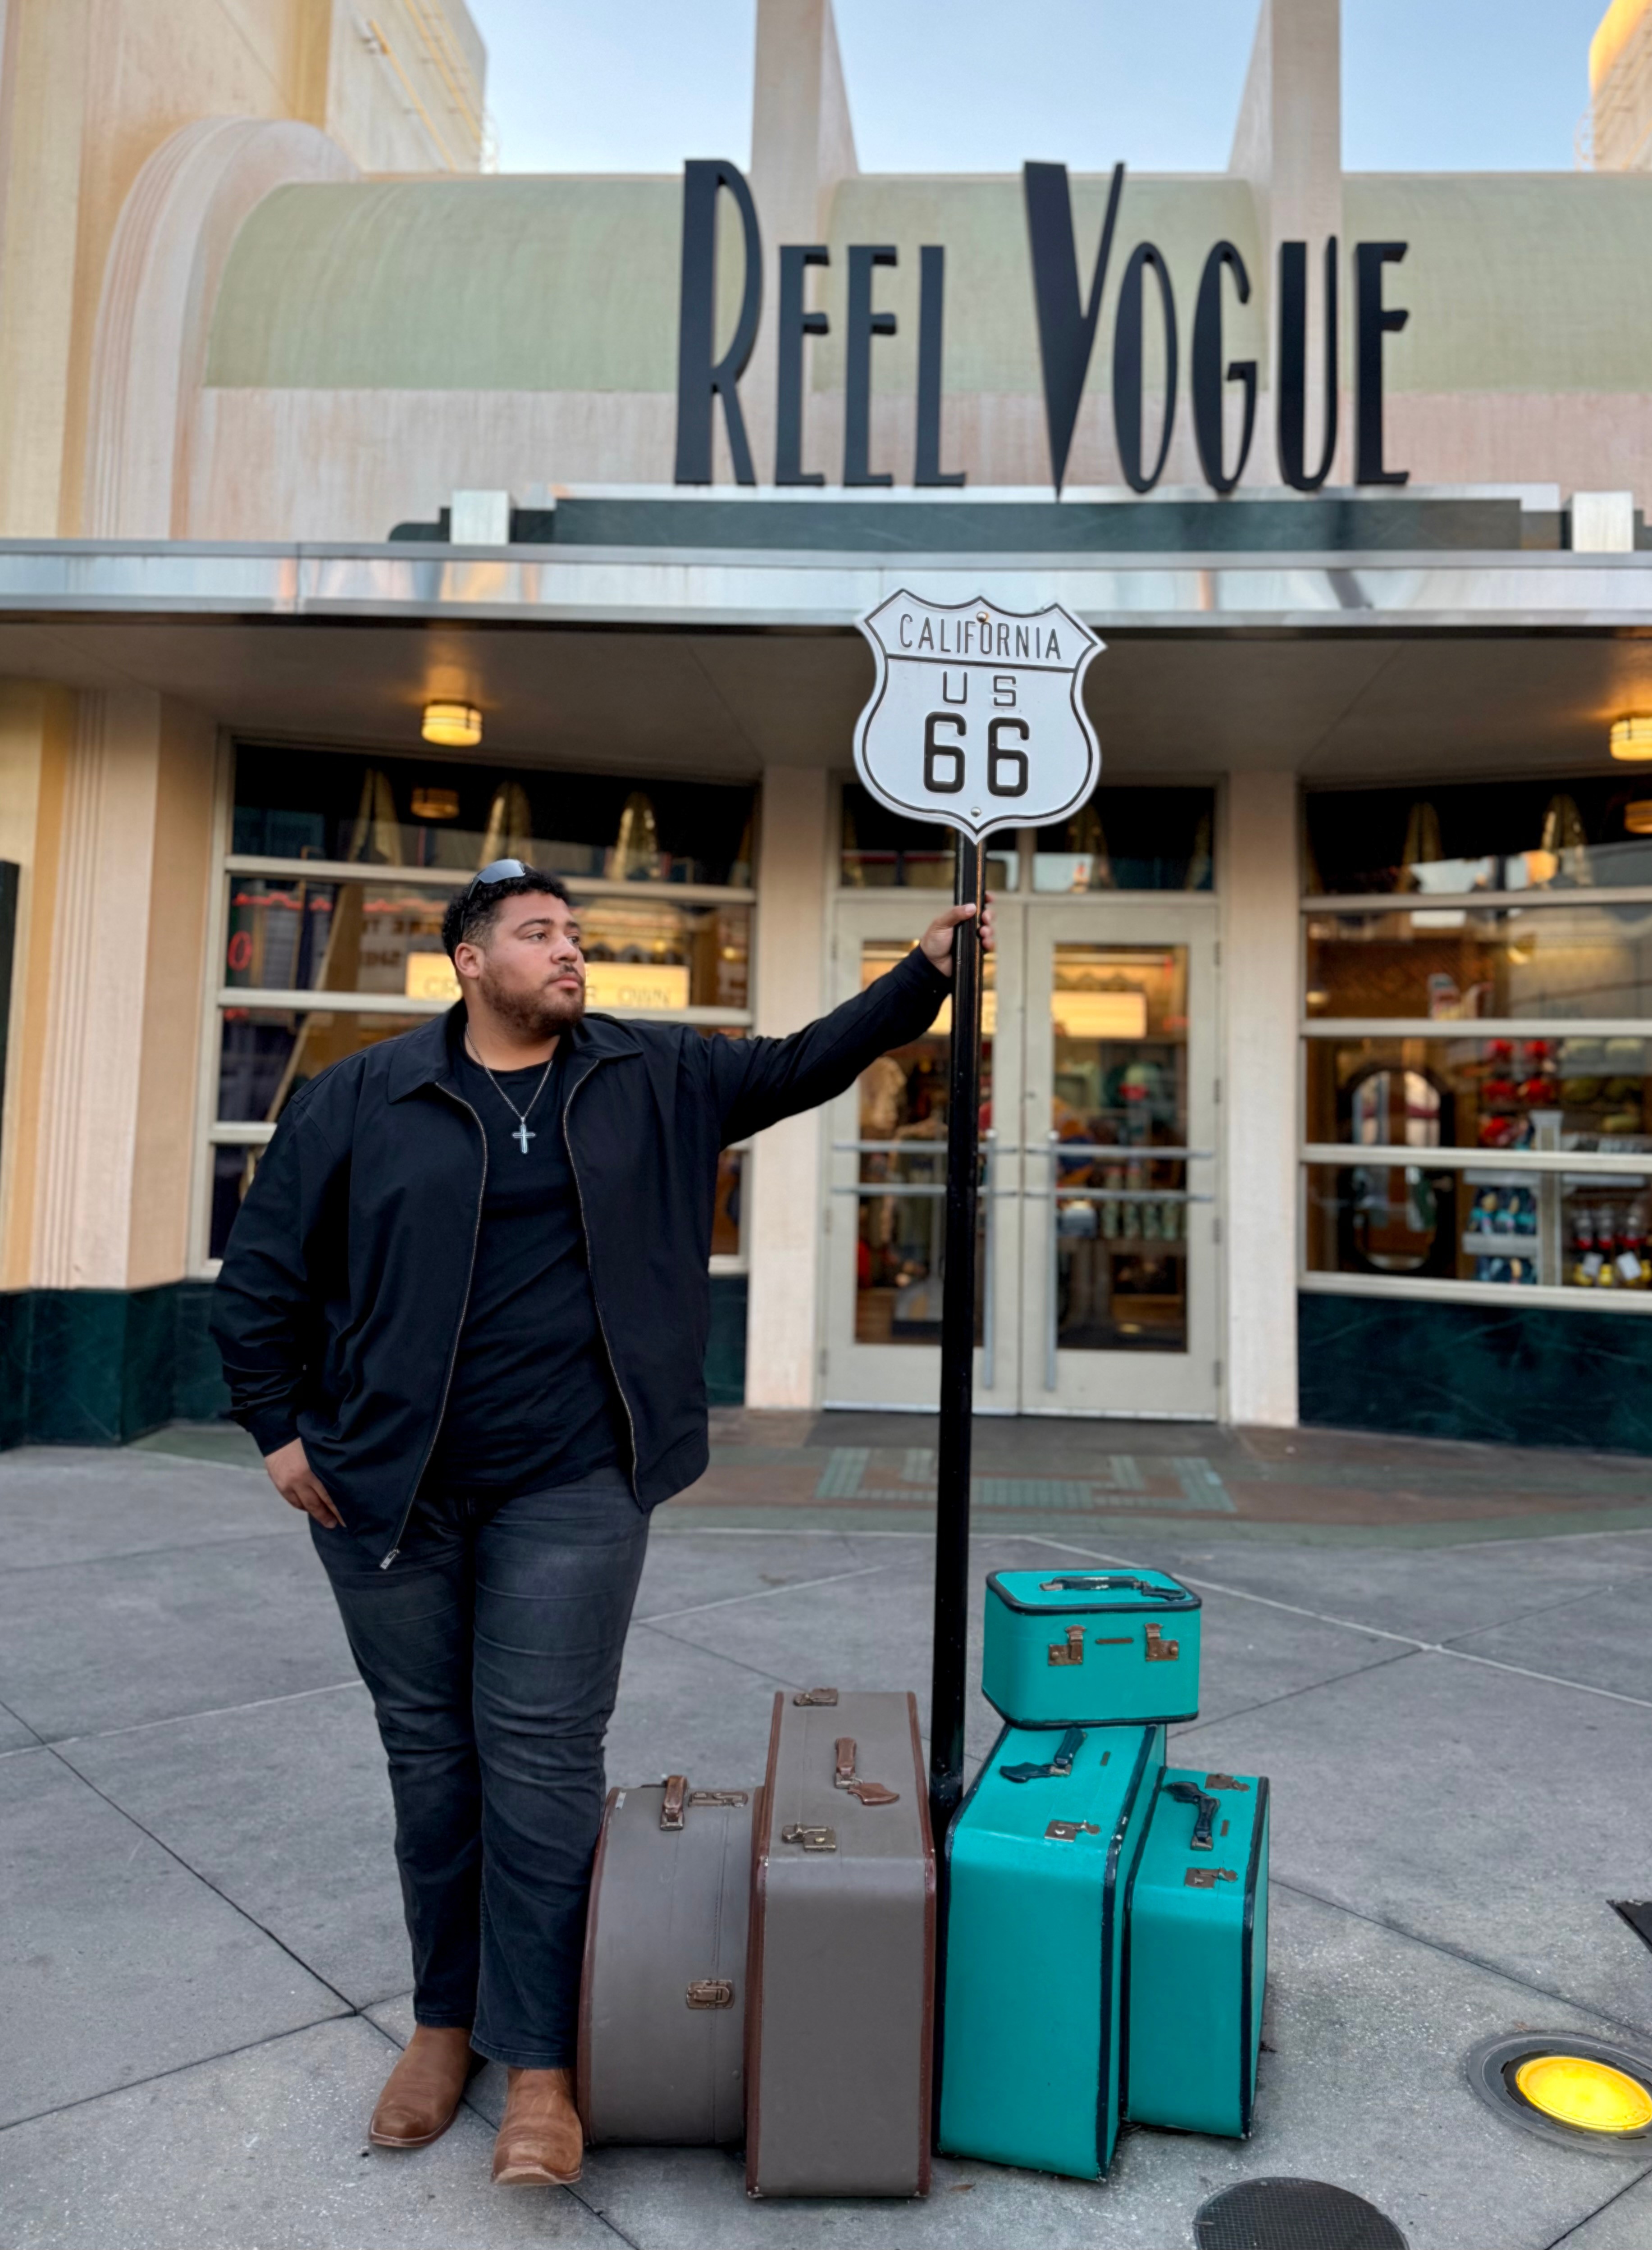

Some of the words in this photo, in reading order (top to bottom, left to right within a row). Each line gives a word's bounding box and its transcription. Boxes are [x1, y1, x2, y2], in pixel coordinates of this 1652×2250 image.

[675, 160, 965, 486] REEL
[1023, 161, 1409, 502] VOGUE
[900, 614, 1061, 659] CALIFORNIA
[924, 712, 1030, 797] 66
